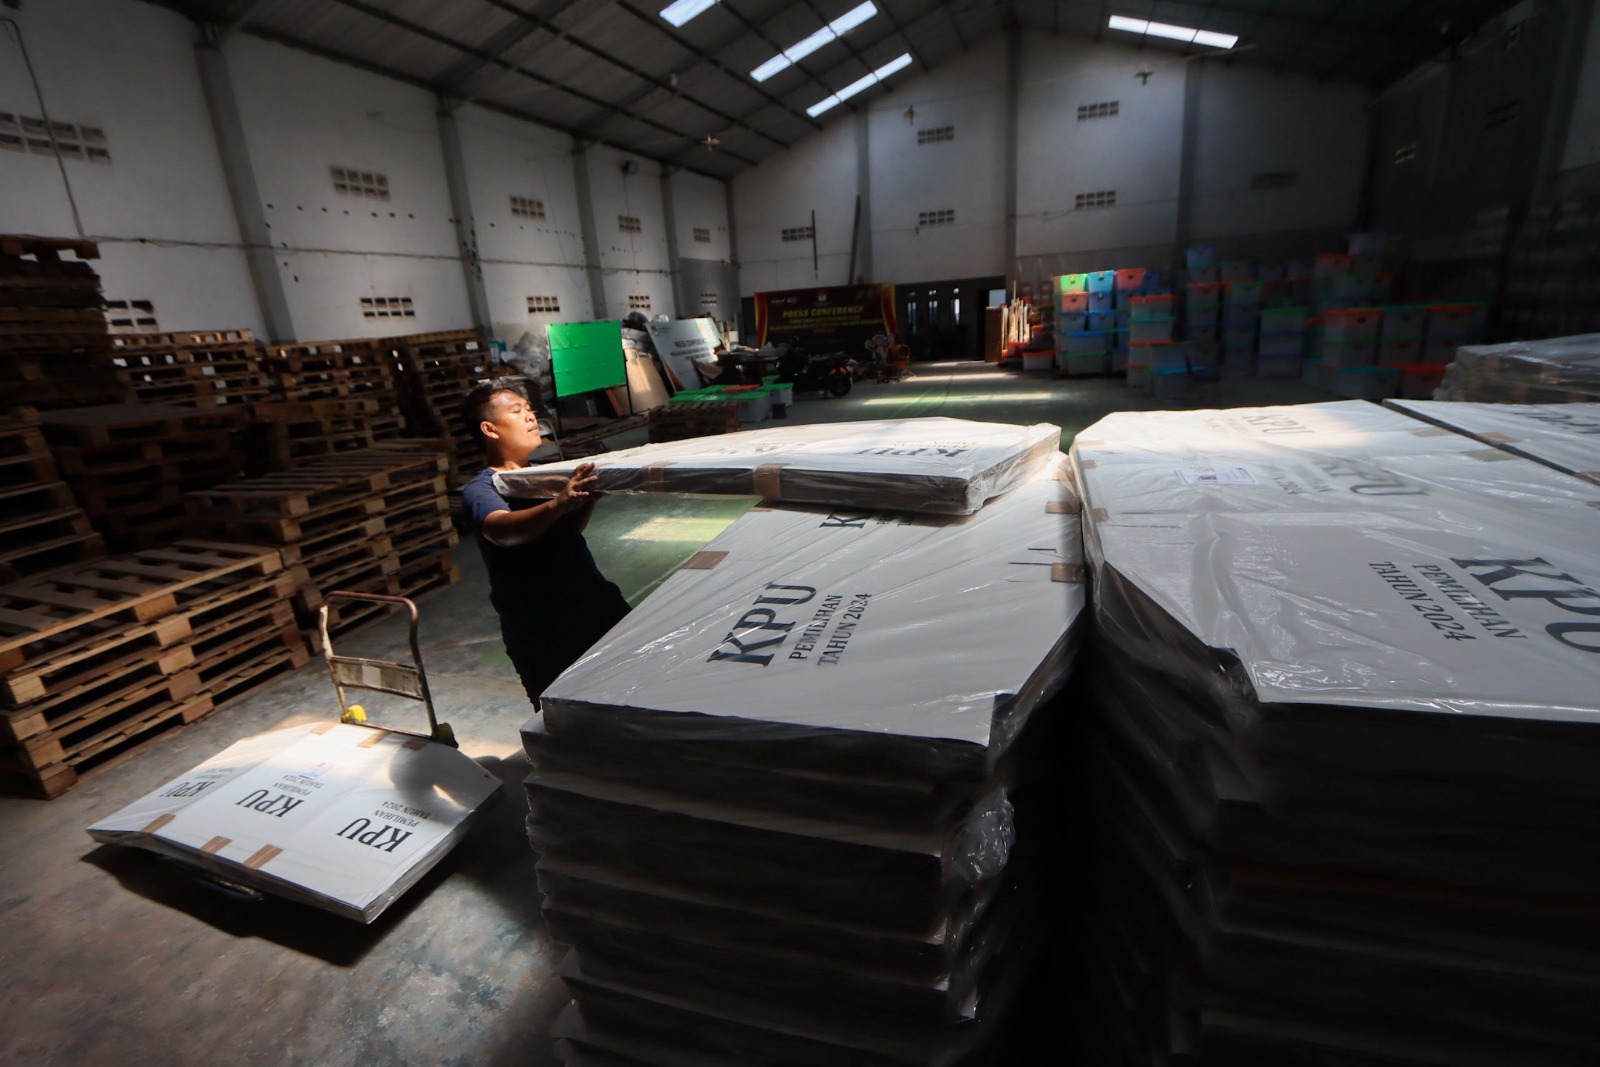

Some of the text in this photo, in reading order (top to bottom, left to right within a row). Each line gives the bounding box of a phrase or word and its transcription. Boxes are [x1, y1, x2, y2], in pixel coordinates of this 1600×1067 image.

[782, 305, 865, 318] PRESS CONFERENCE
[1367, 561, 1478, 642] TAHUN 2024
[1411, 563, 1529, 640] PEMILIHAN
[706, 582, 818, 667] KPU
[788, 594, 844, 661] PEMILIHAN
[816, 592, 873, 667] TAHUN 2024
[158, 781, 216, 798] KPU
[234, 789, 305, 818] KPU
[371, 809, 420, 829] PEMILIHAN
[381, 800, 432, 820] TAHUN 2024
[335, 817, 414, 853] KPU
